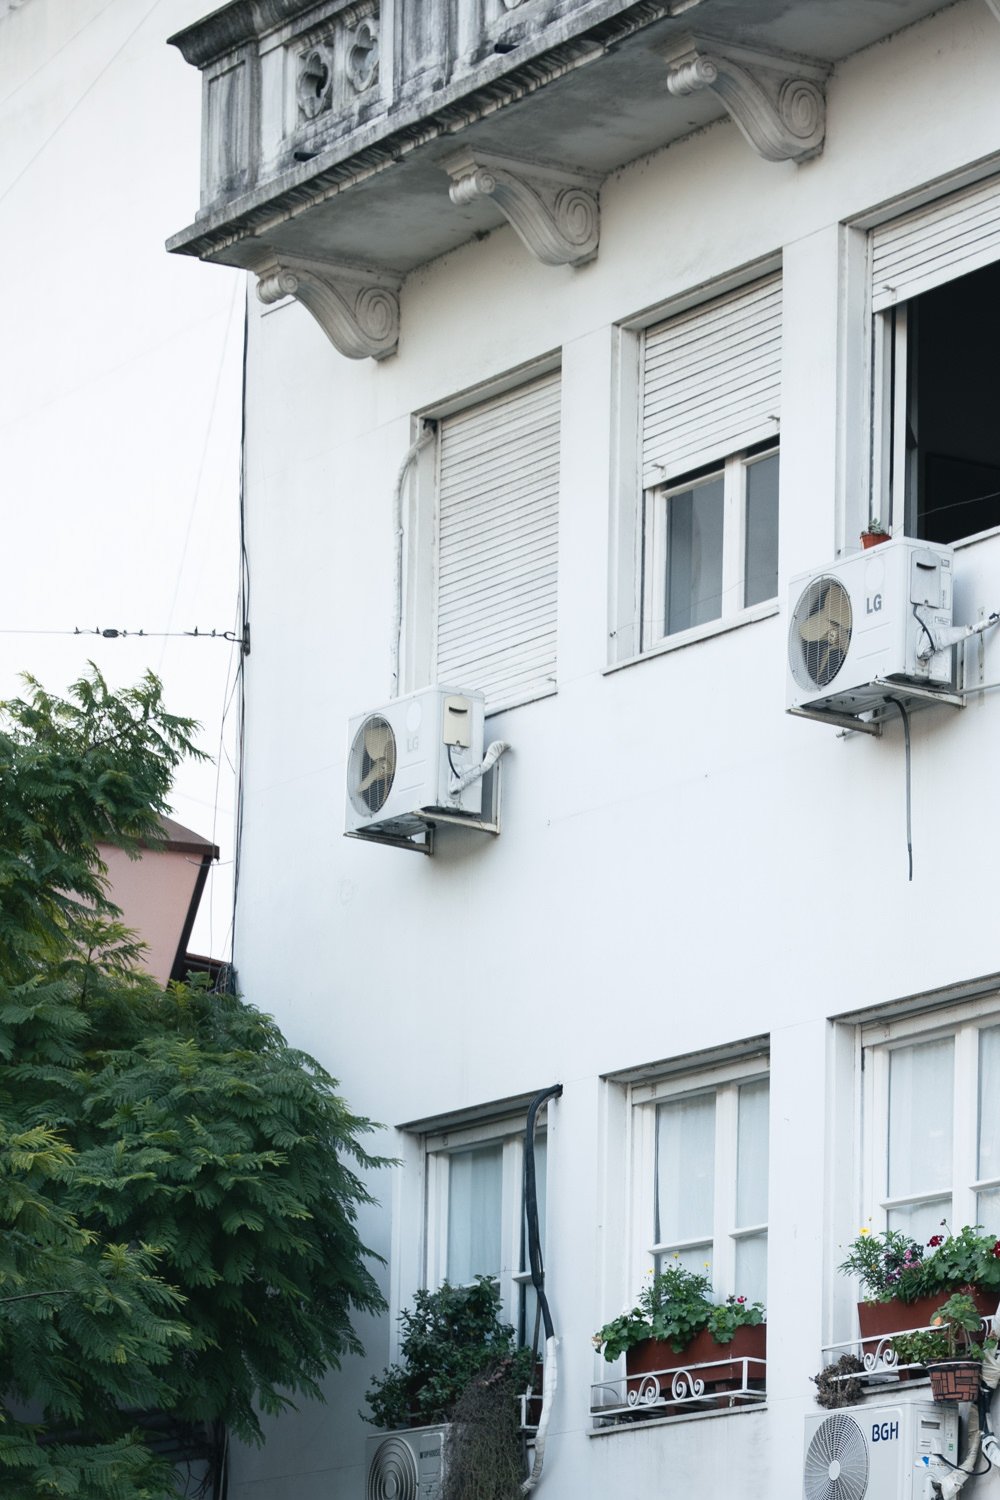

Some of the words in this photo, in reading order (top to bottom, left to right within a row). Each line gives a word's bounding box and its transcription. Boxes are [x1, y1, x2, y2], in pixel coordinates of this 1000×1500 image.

[866, 593, 882, 614] LG
[406, 735, 419, 752] LG
[872, 1421, 899, 1442] BGH
